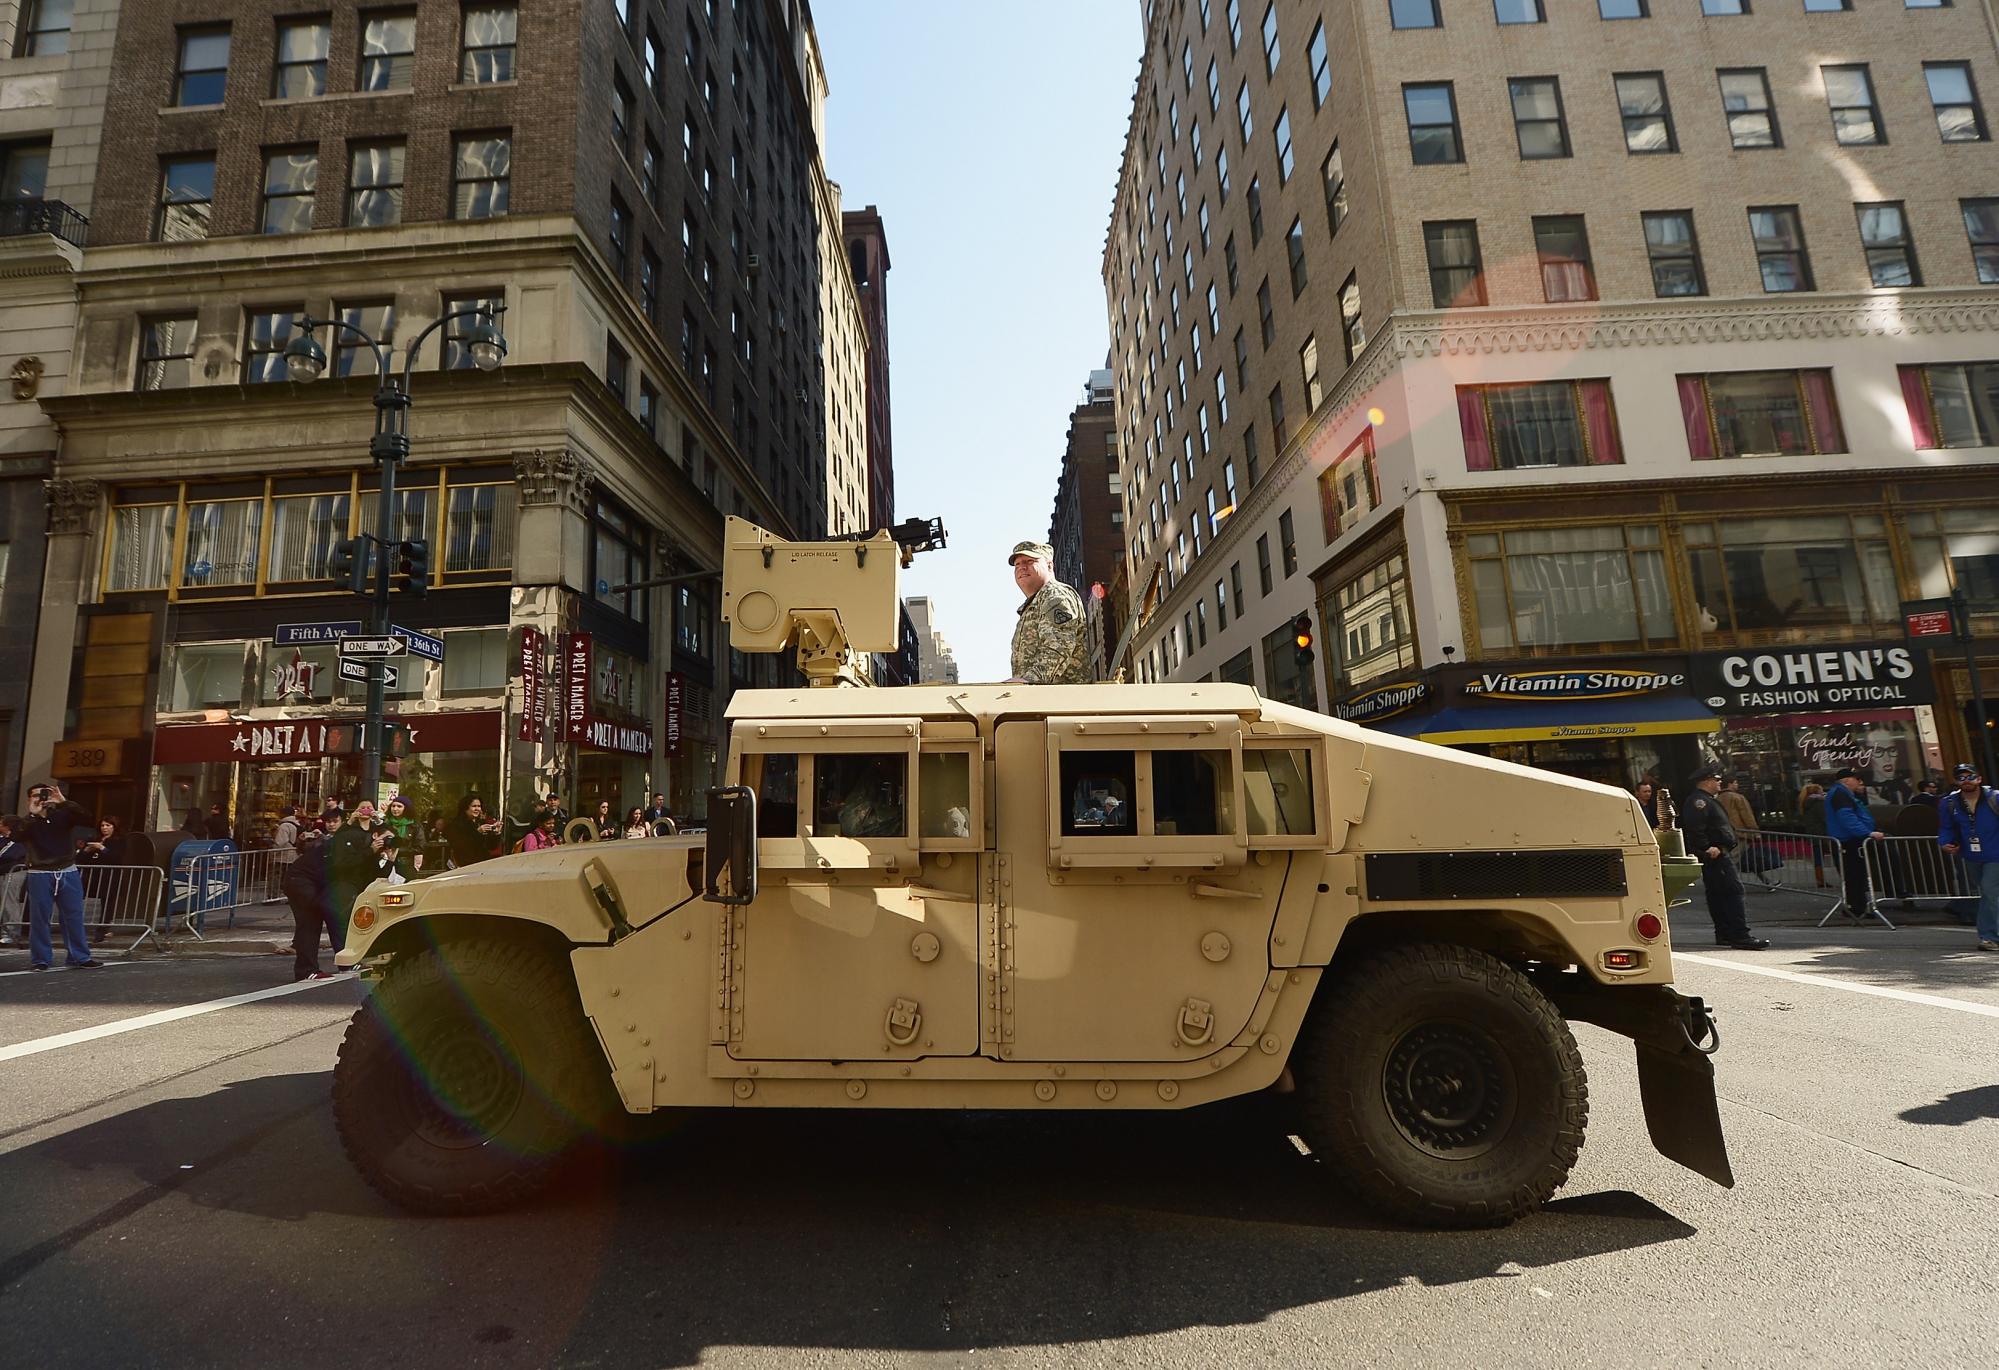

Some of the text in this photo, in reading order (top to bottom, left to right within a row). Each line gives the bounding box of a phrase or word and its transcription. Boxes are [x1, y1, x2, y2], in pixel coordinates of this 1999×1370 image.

[289, 626, 348, 640] Fifth Ave
[348, 642, 397, 651] ONE WAY
[413, 637, 430, 652] 36th
[431, 644, 440, 655] St
[345, 664, 366, 675] ONE
[523, 648, 533, 671] PRET
[571, 652, 586, 674] PRET
[1722, 647, 1914, 688] COHEN'S
[273, 661, 319, 693] PRET
[602, 671, 621, 697] PRET
[1465, 672, 1685, 693] THE Vitamin Shoppe
[523, 682, 532, 720] MANGER
[570, 685, 585, 721] MANGER
[669, 687, 680, 704] PRET
[1336, 684, 1425, 720] Vitamin Shoppe
[1740, 685, 1907, 707] FASHION OPTICAL
[594, 721, 647, 754] PRET A MANGER
[668, 713, 680, 741] MANGER
[250, 725, 296, 756] PRET
[298, 725, 312, 753] A
[1798, 731, 1853, 757] Grand
[67, 748, 105, 768] 389
